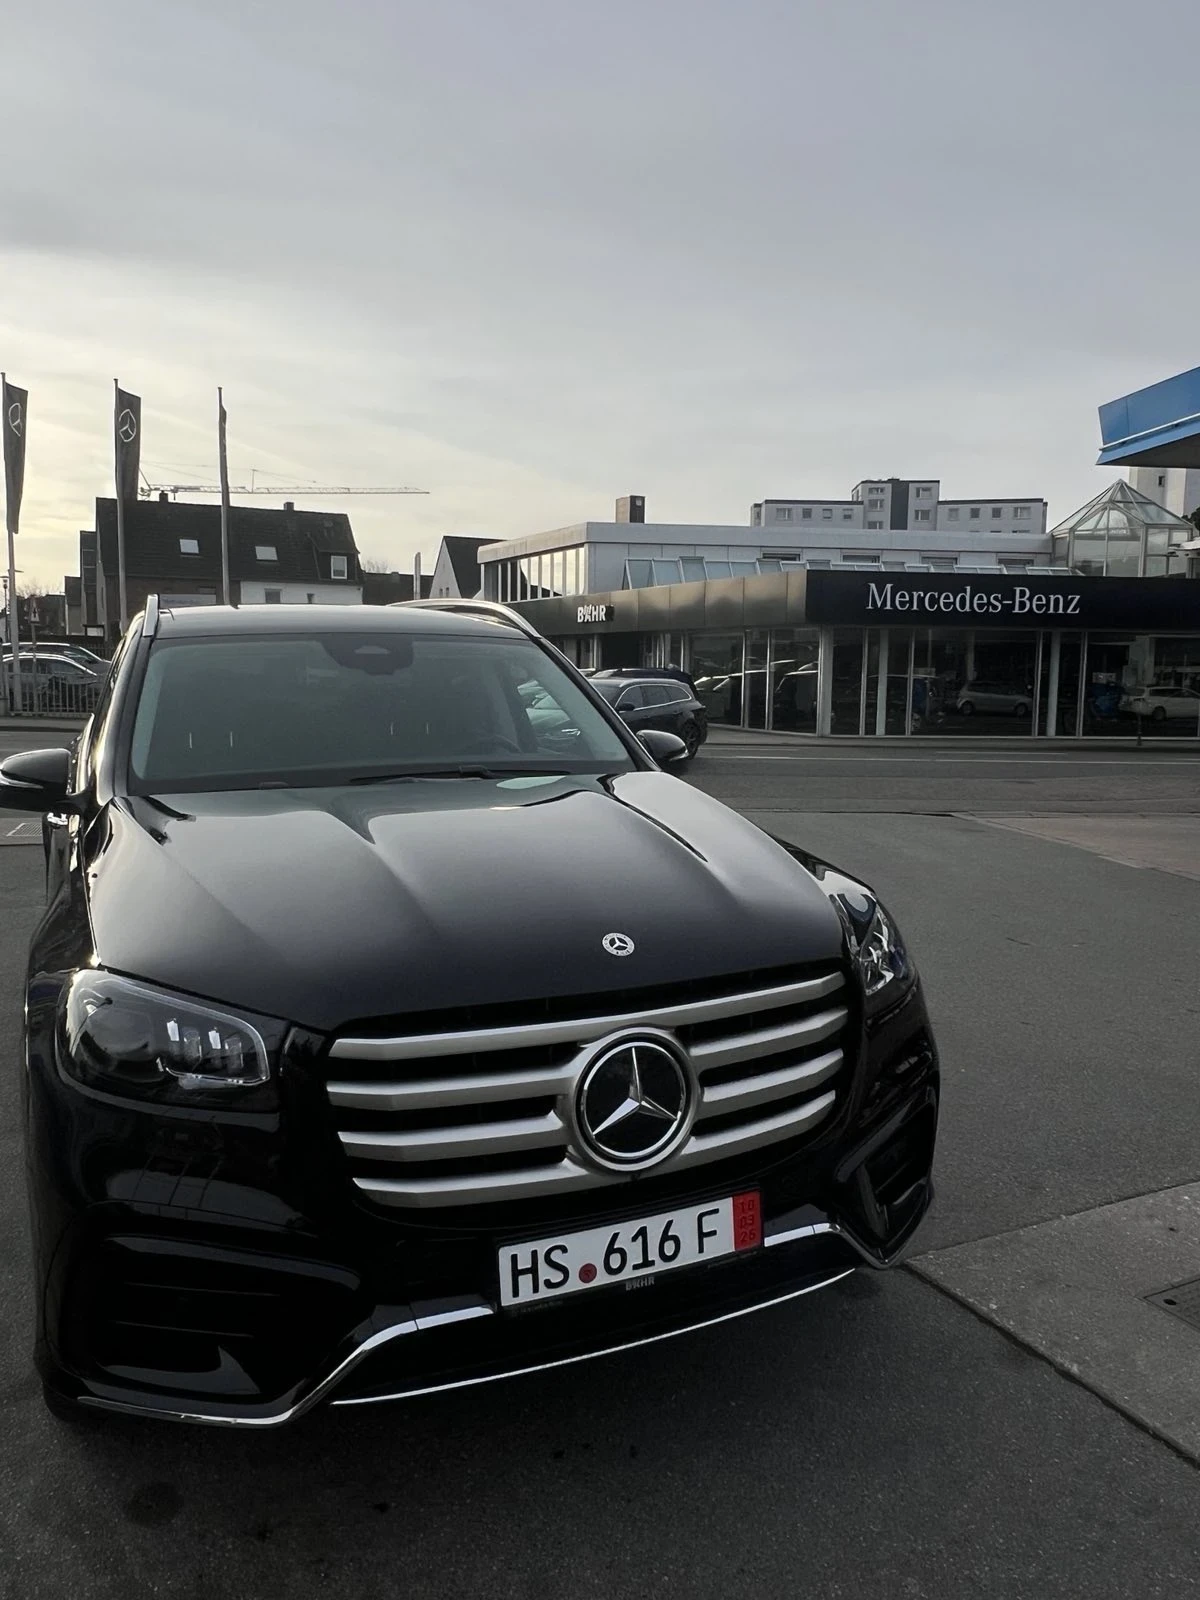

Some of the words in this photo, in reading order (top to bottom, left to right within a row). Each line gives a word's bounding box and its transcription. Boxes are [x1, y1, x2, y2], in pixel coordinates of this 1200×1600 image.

[866, 582, 1081, 615] Mercedes-Benz
[510, 1244, 570, 1298] HS
[603, 1219, 681, 1275] 616
[696, 1208, 719, 1254] F
